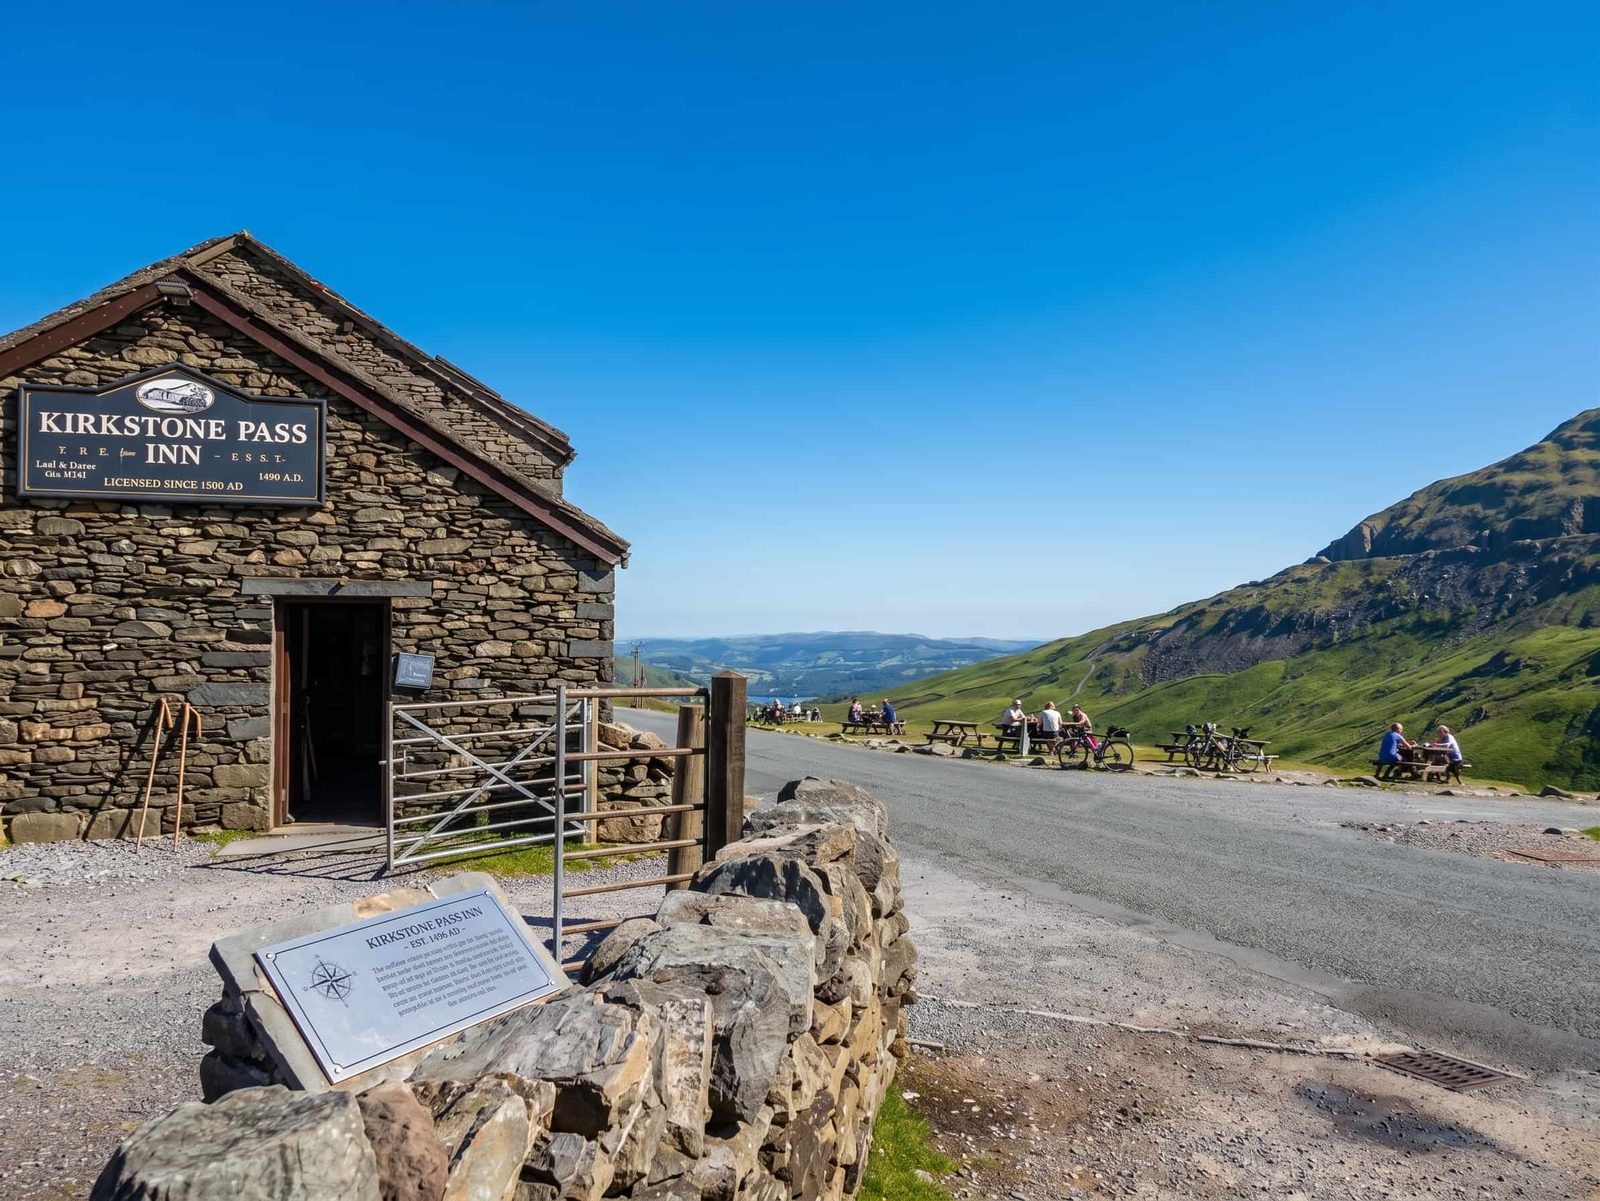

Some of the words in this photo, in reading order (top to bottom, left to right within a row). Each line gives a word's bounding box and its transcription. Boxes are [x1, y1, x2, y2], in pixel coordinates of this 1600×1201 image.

[39, 412, 226, 440] KIRKSTONE
[237, 420, 308, 444] PASS
[145, 443, 202, 465] INN
[104, 477, 161, 488] LICENSED
[163, 479, 198, 490] SINCE
[201, 481, 225, 490] 1500
[226, 481, 244, 491] AD
[258, 472, 281, 482] 1490
[283, 473, 304, 483] A.D.
[365, 920, 436, 950] KIRKSTONE
[435, 913, 462, 929] PASS
[460, 906, 484, 921] INN
[410, 938, 429, 949] EST.
[429, 932, 448, 943] 1496
[448, 927, 461, 937] AD
